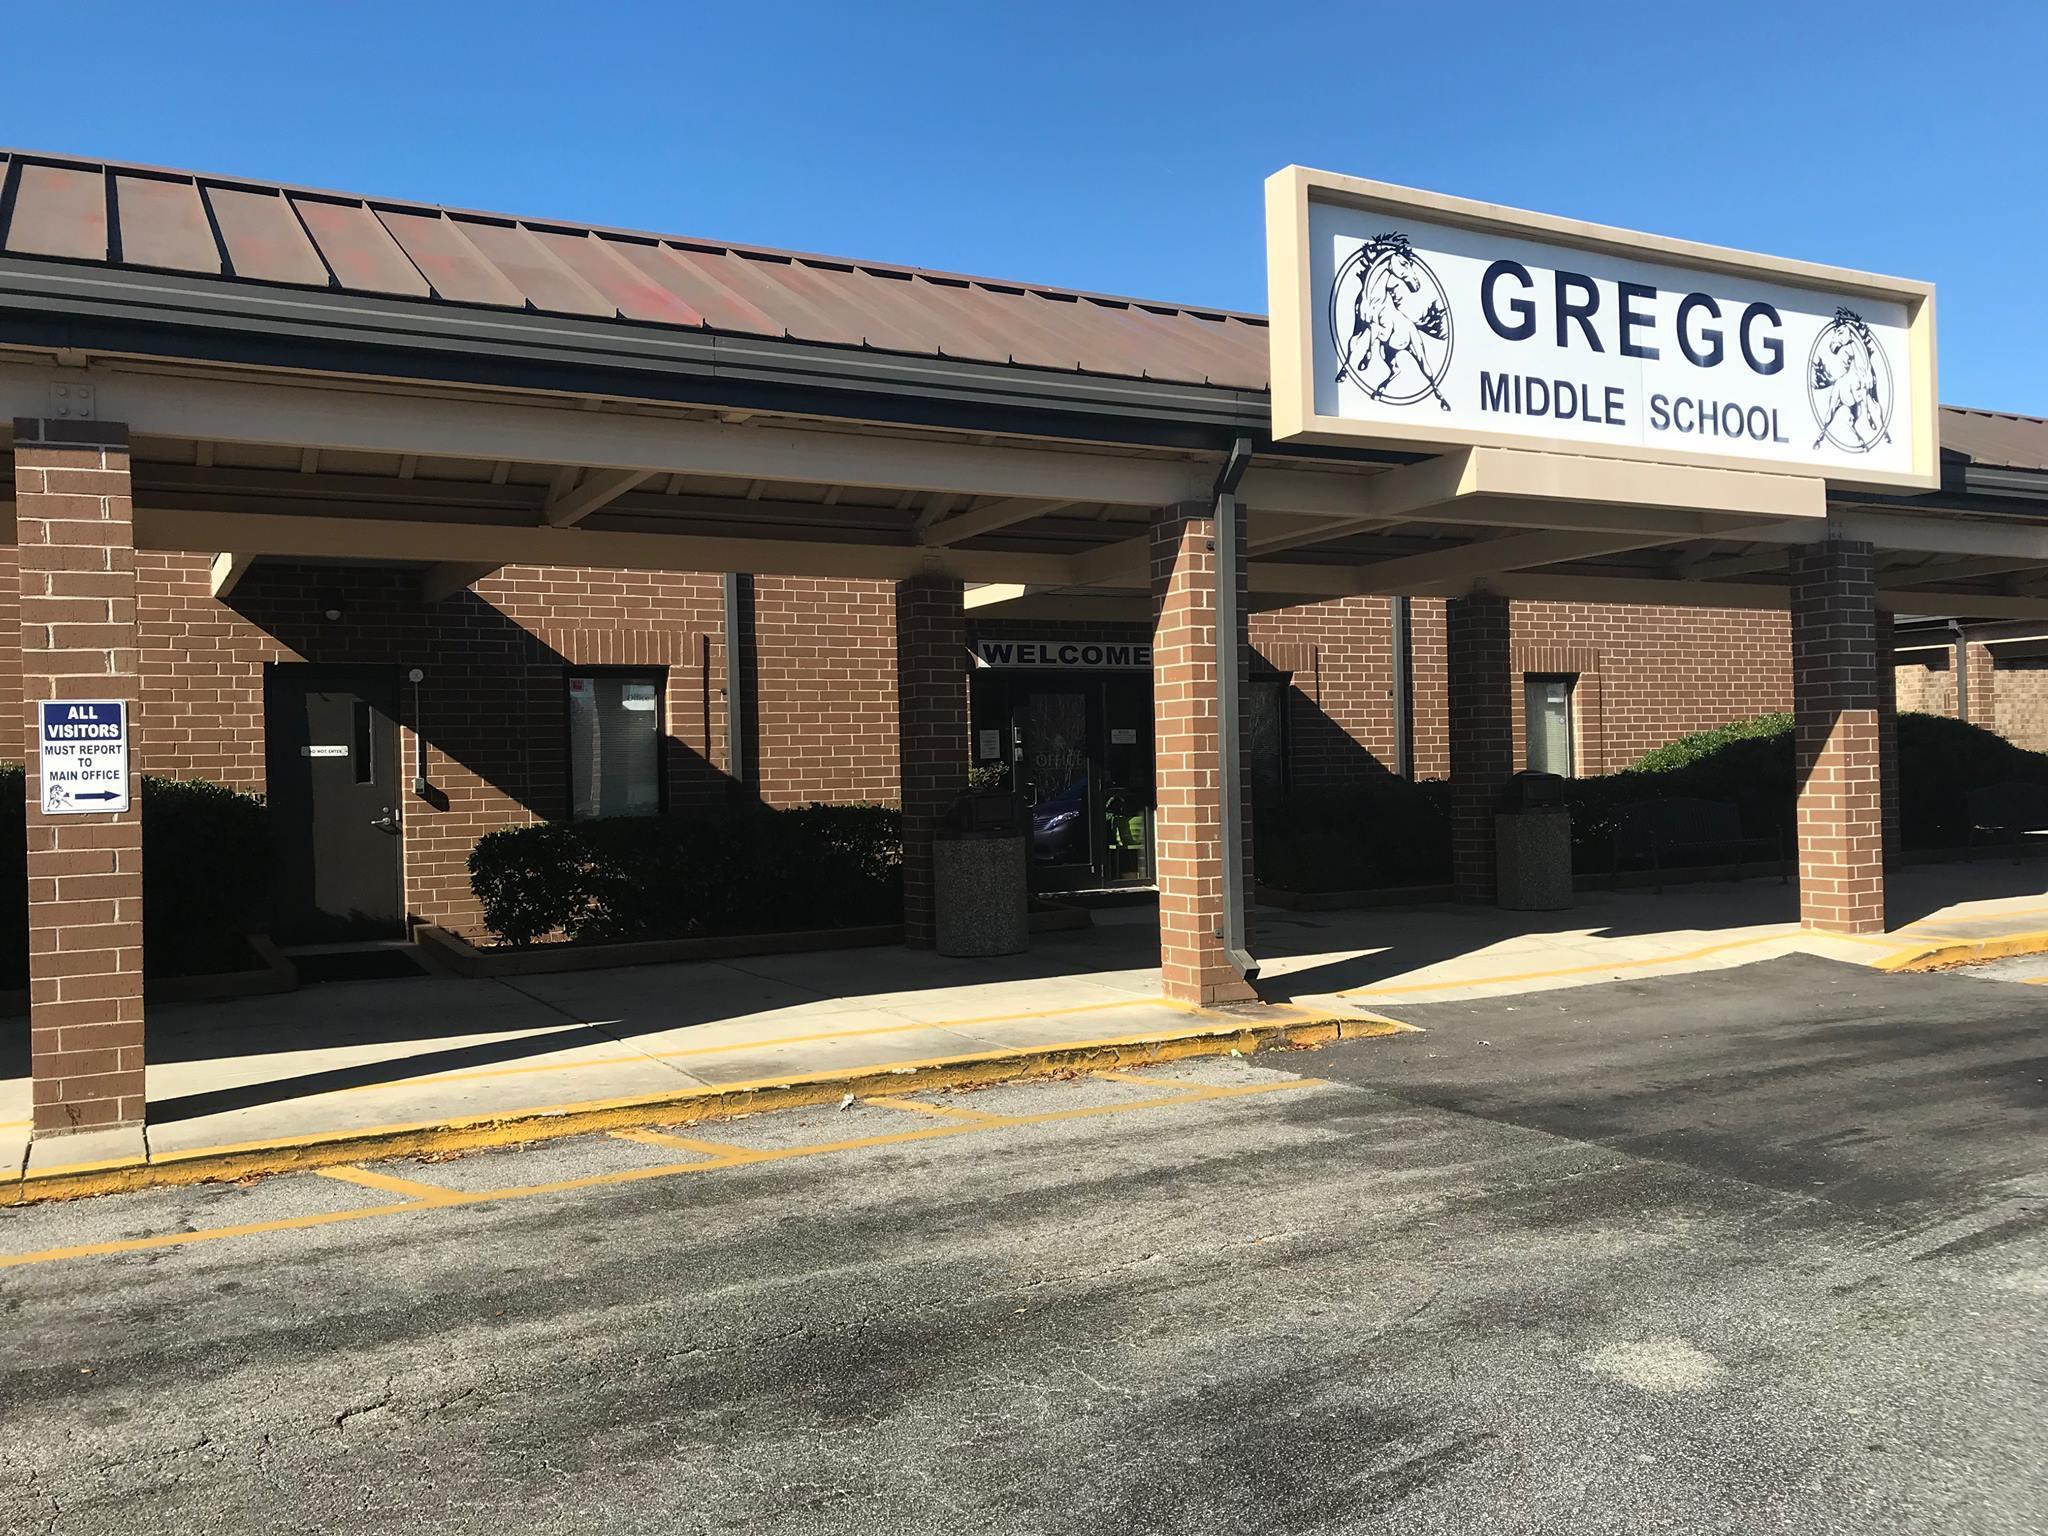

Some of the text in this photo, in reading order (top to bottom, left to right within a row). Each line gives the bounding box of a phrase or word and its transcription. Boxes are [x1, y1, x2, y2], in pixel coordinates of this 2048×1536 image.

[1481, 259, 1784, 376] GREGG
[1480, 371, 1789, 443] MIDDLE SCHOOL
[983, 644, 1150, 665] WELCOME
[67, 706, 98, 720] ALL
[47, 724, 119, 738] VISITORS
[45, 744, 122, 756] MUST REPORT
[78, 758, 92, 767] TO
[49, 770, 120, 781] MAIN OFFICE
